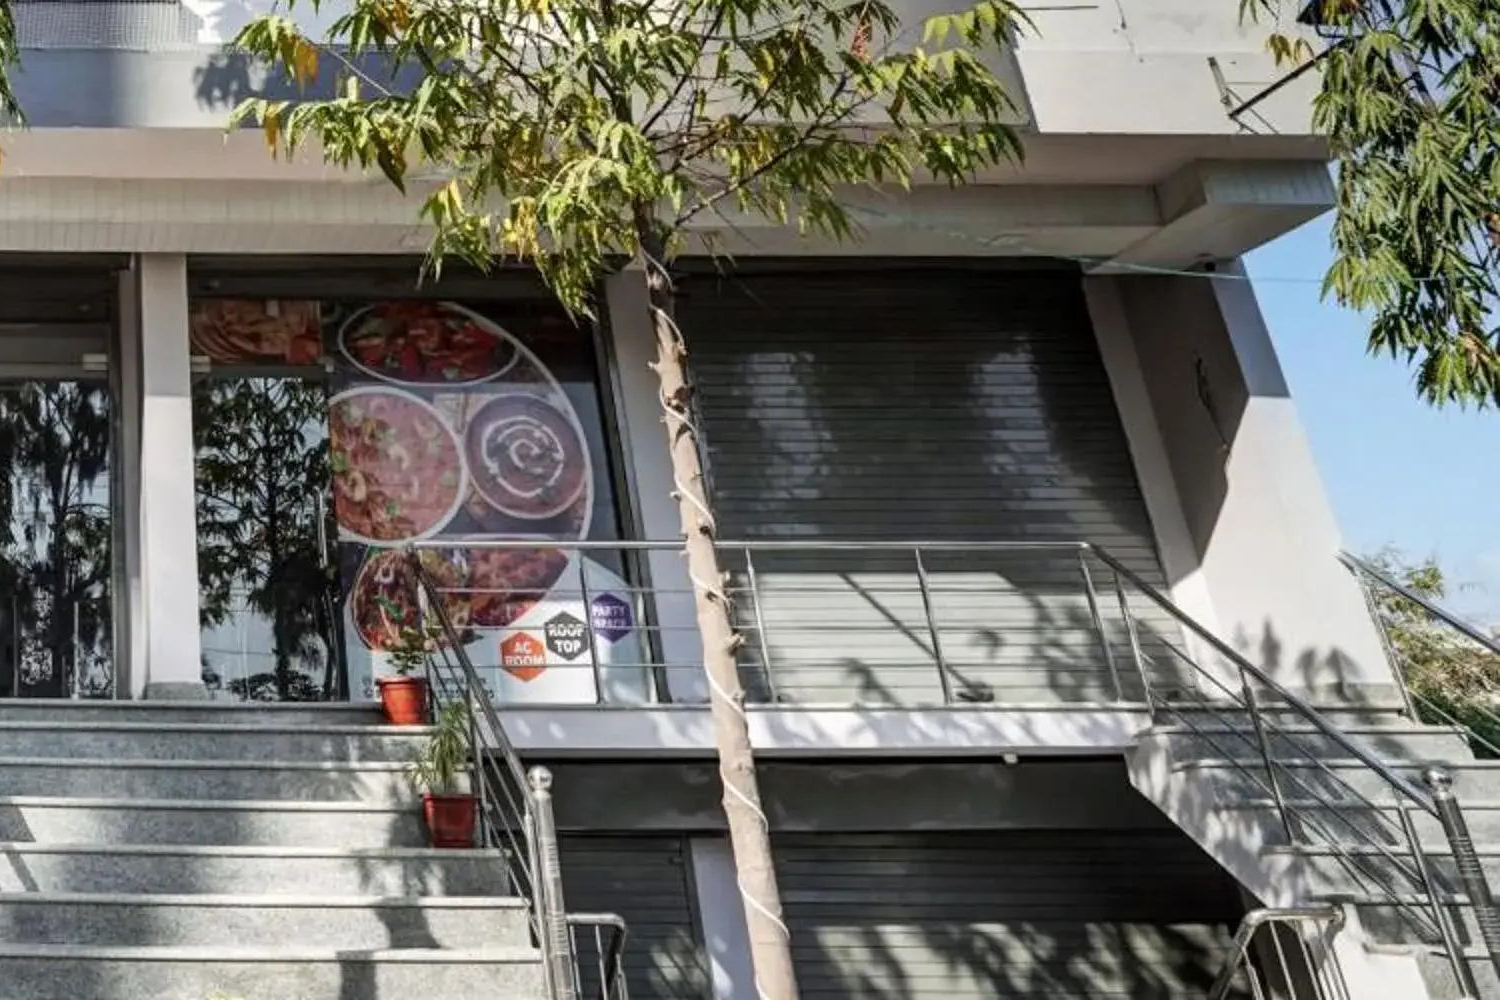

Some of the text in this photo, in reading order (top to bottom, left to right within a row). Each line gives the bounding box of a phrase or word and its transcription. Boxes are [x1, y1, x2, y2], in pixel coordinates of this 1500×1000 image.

[548, 624, 585, 637] ROOF
[514, 642, 533, 655] AC
[554, 639, 581, 652] TOP
